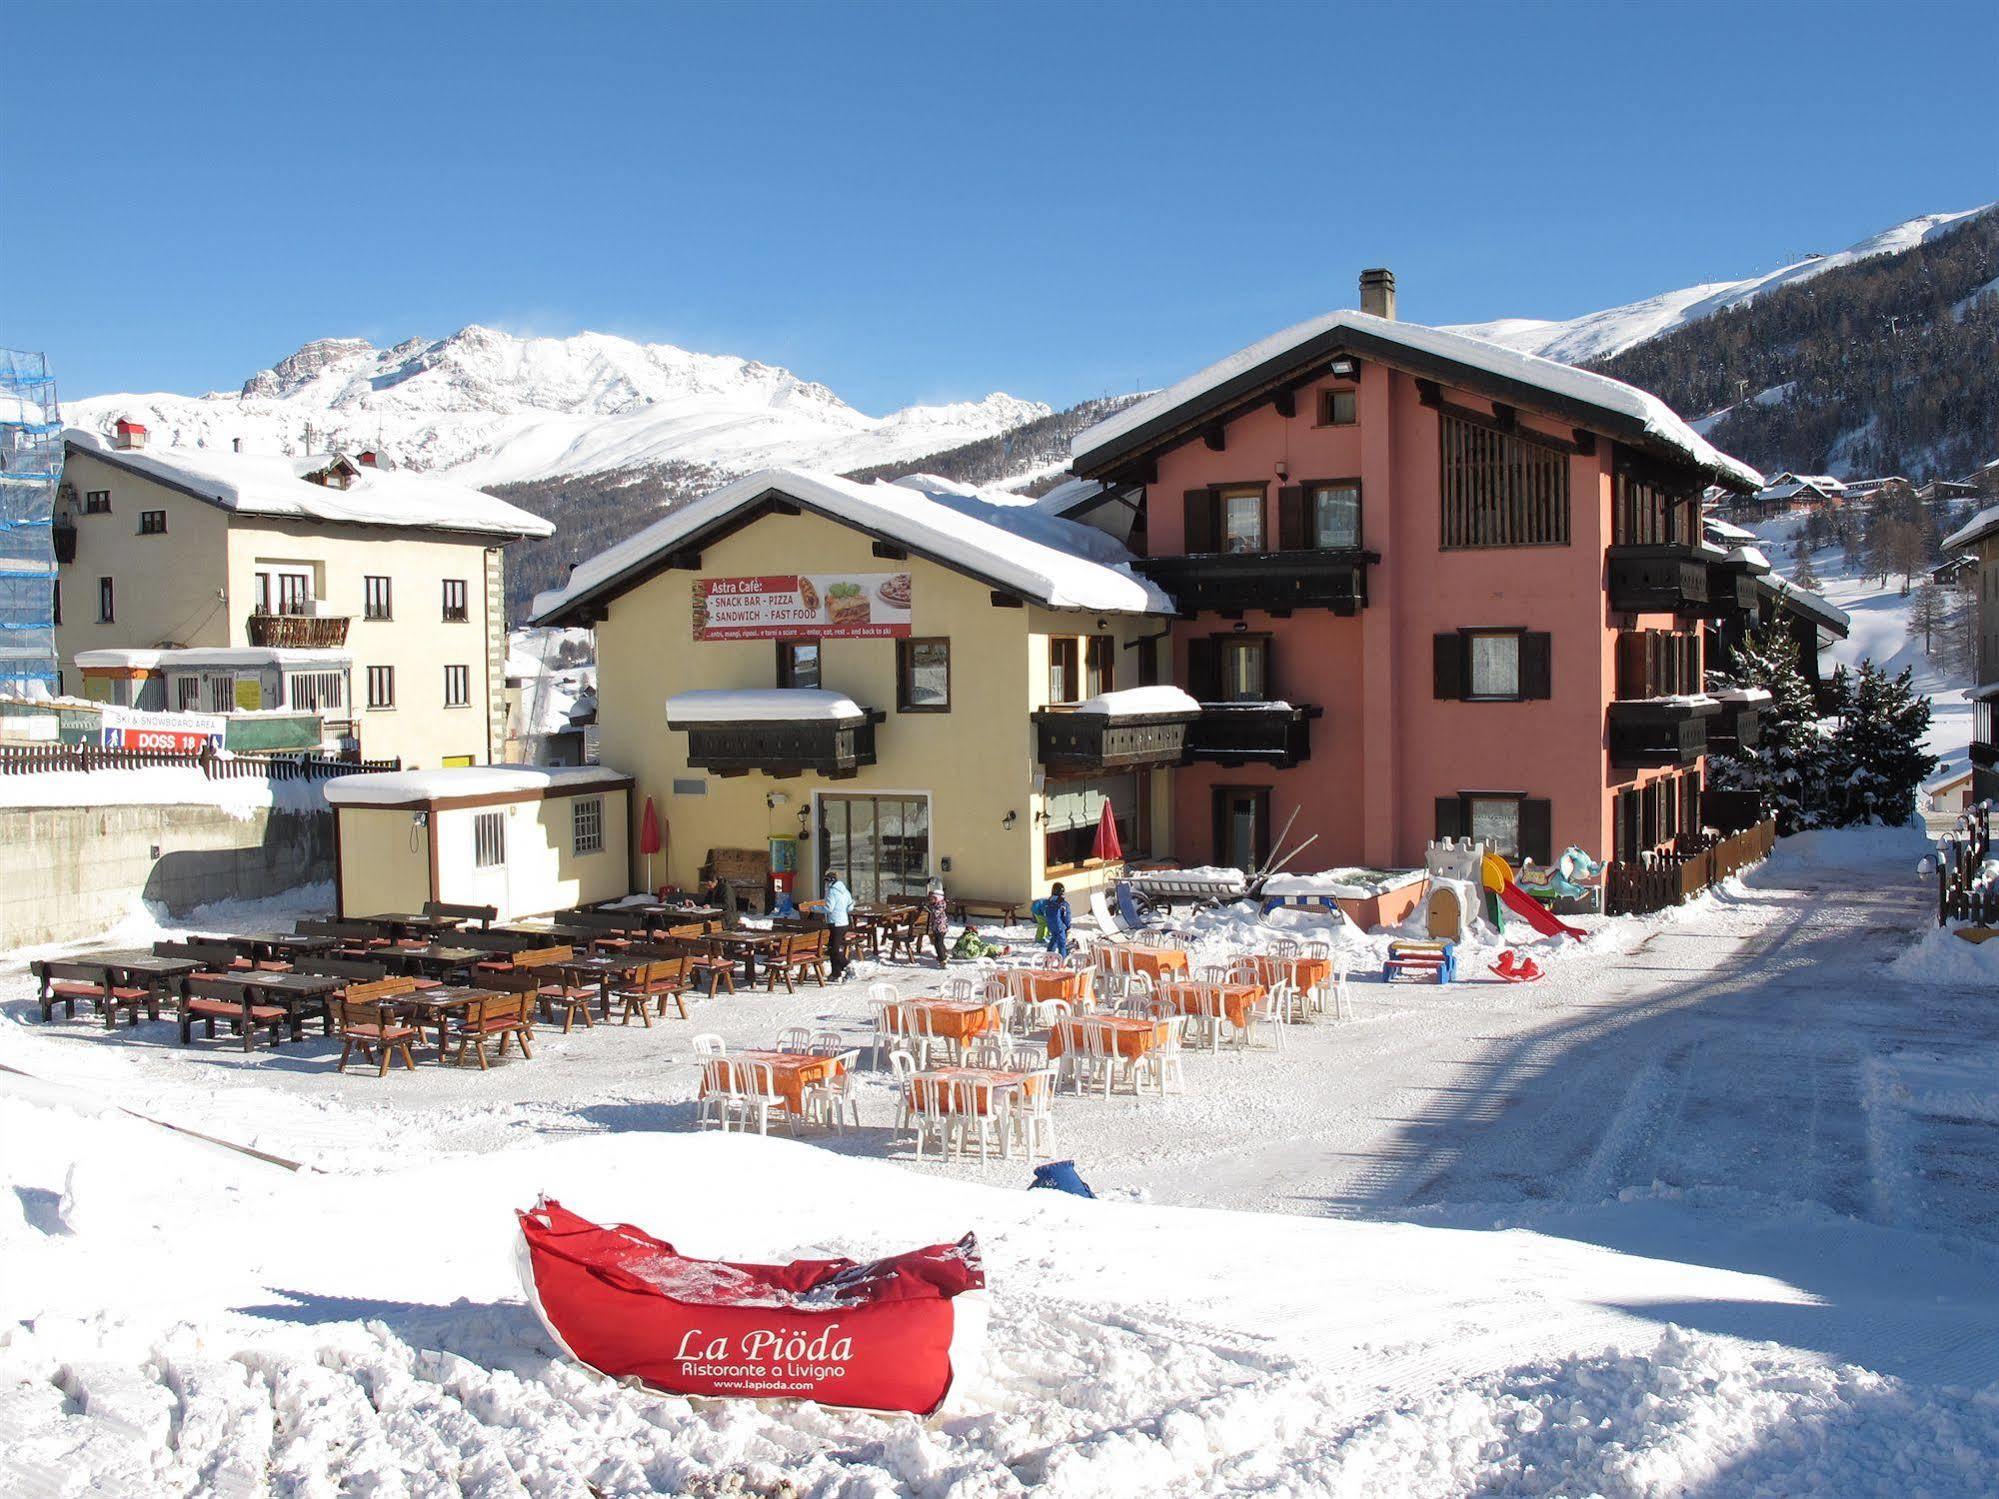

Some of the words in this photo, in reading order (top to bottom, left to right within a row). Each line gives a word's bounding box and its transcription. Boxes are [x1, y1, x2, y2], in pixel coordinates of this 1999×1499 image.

[711, 582, 736, 594] Astra
[715, 597, 744, 607] SNACK
[744, 596, 761, 606] BAR
[768, 595, 794, 606] PIZZA
[715, 611, 760, 622] SANDWICH
[770, 610, 790, 620] FAST
[793, 609, 816, 620] FOOD
[117, 714, 130, 724] SKI
[132, 716, 138, 724] &
[141, 716, 192, 728] SNOWBOARD
[195, 719, 216, 729] AREA
[139, 733, 176, 749] DOSS
[182, 735, 196, 750] 18
[673, 1329, 729, 1361] La
[741, 1323, 854, 1361] Piöda
[682, 1361, 766, 1377] Ristorante
[771, 1366, 783, 1377] a
[788, 1363, 845, 1381] Livigno
[713, 1380, 814, 1391] www.lapioda.com
